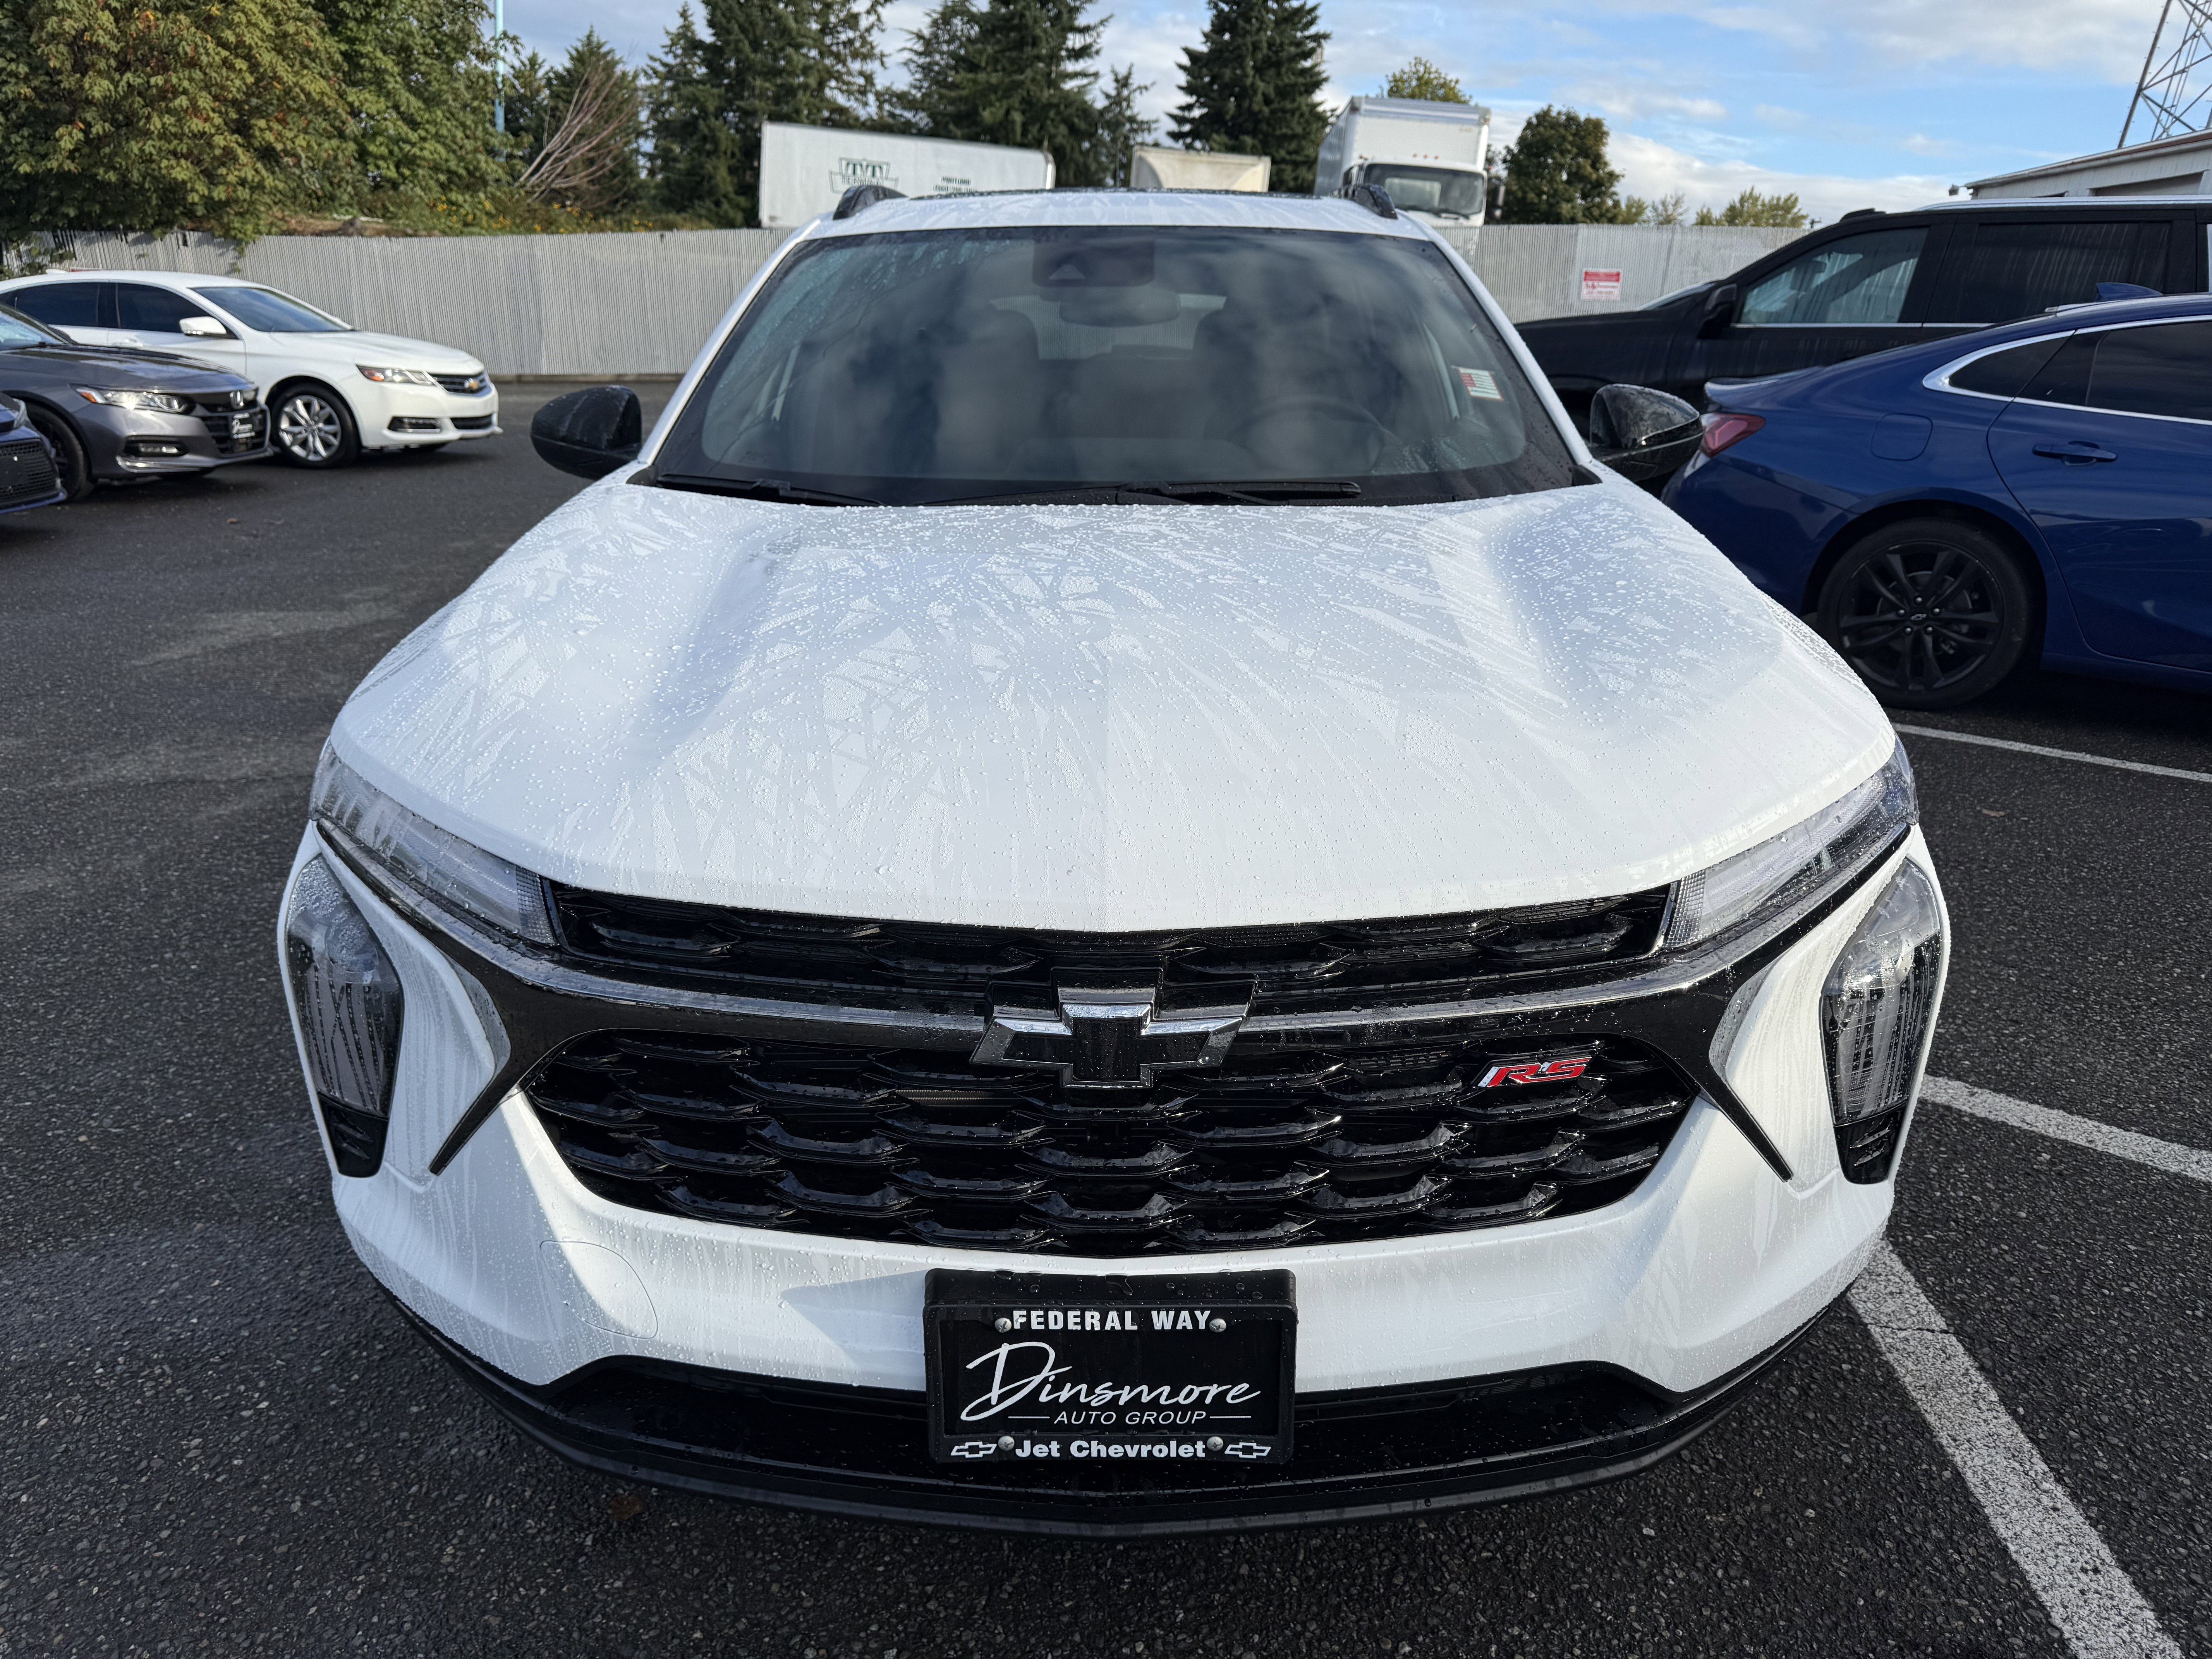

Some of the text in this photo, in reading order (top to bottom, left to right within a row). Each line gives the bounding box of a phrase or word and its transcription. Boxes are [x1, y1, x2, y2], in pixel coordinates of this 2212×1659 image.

[1478, 1057, 1592, 1087] RS
[1013, 1309, 1211, 1330] FEDERAL WAY
[960, 1341, 1261, 1421] Dinsmore
[1054, 1411, 1206, 1424] AUTO GROUP
[1015, 1440, 1206, 1458] Jet Chevrolet
